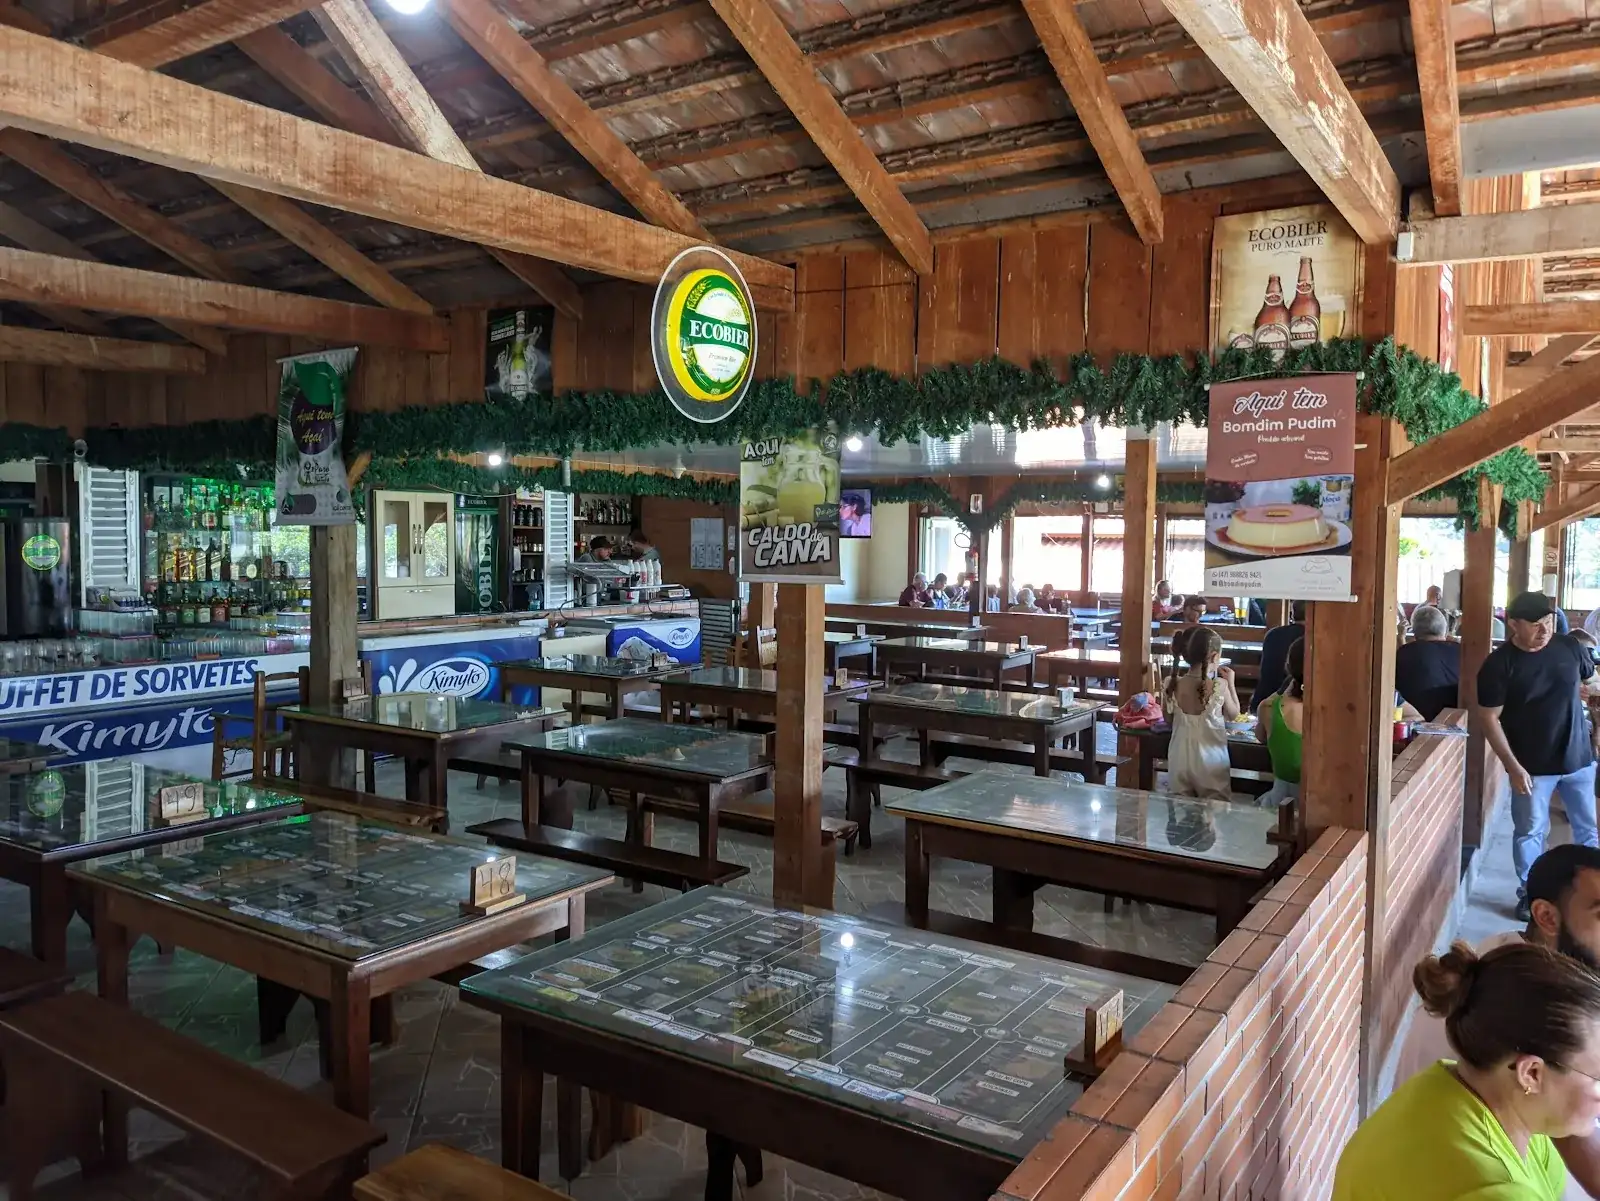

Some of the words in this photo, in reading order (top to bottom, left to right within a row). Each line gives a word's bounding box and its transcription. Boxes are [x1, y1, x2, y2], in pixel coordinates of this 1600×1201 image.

[1248, 220, 1328, 242] ECOBIER
[1251, 242, 1282, 252] PURO
[1285, 237, 1324, 249] MALTE
[690, 319, 749, 350] ECOBIER
[1233, 390, 1287, 418] Aqui
[1292, 386, 1327, 409] tem
[1222, 420, 1284, 433] Bomdim
[1288, 416, 1337, 430] Pudim
[744, 438, 779, 459] AQUI
[762, 457, 774, 466] tem
[748, 522, 811, 546] CALDO
[810, 529, 823, 542] de
[754, 536, 831, 567] CANA
[90, 671, 129, 700] DE
[133, 659, 258, 695] SORVETES
[427, 668, 482, 692] Kimyto
[165, 785, 196, 814] 49
[479, 862, 511, 898] 48
